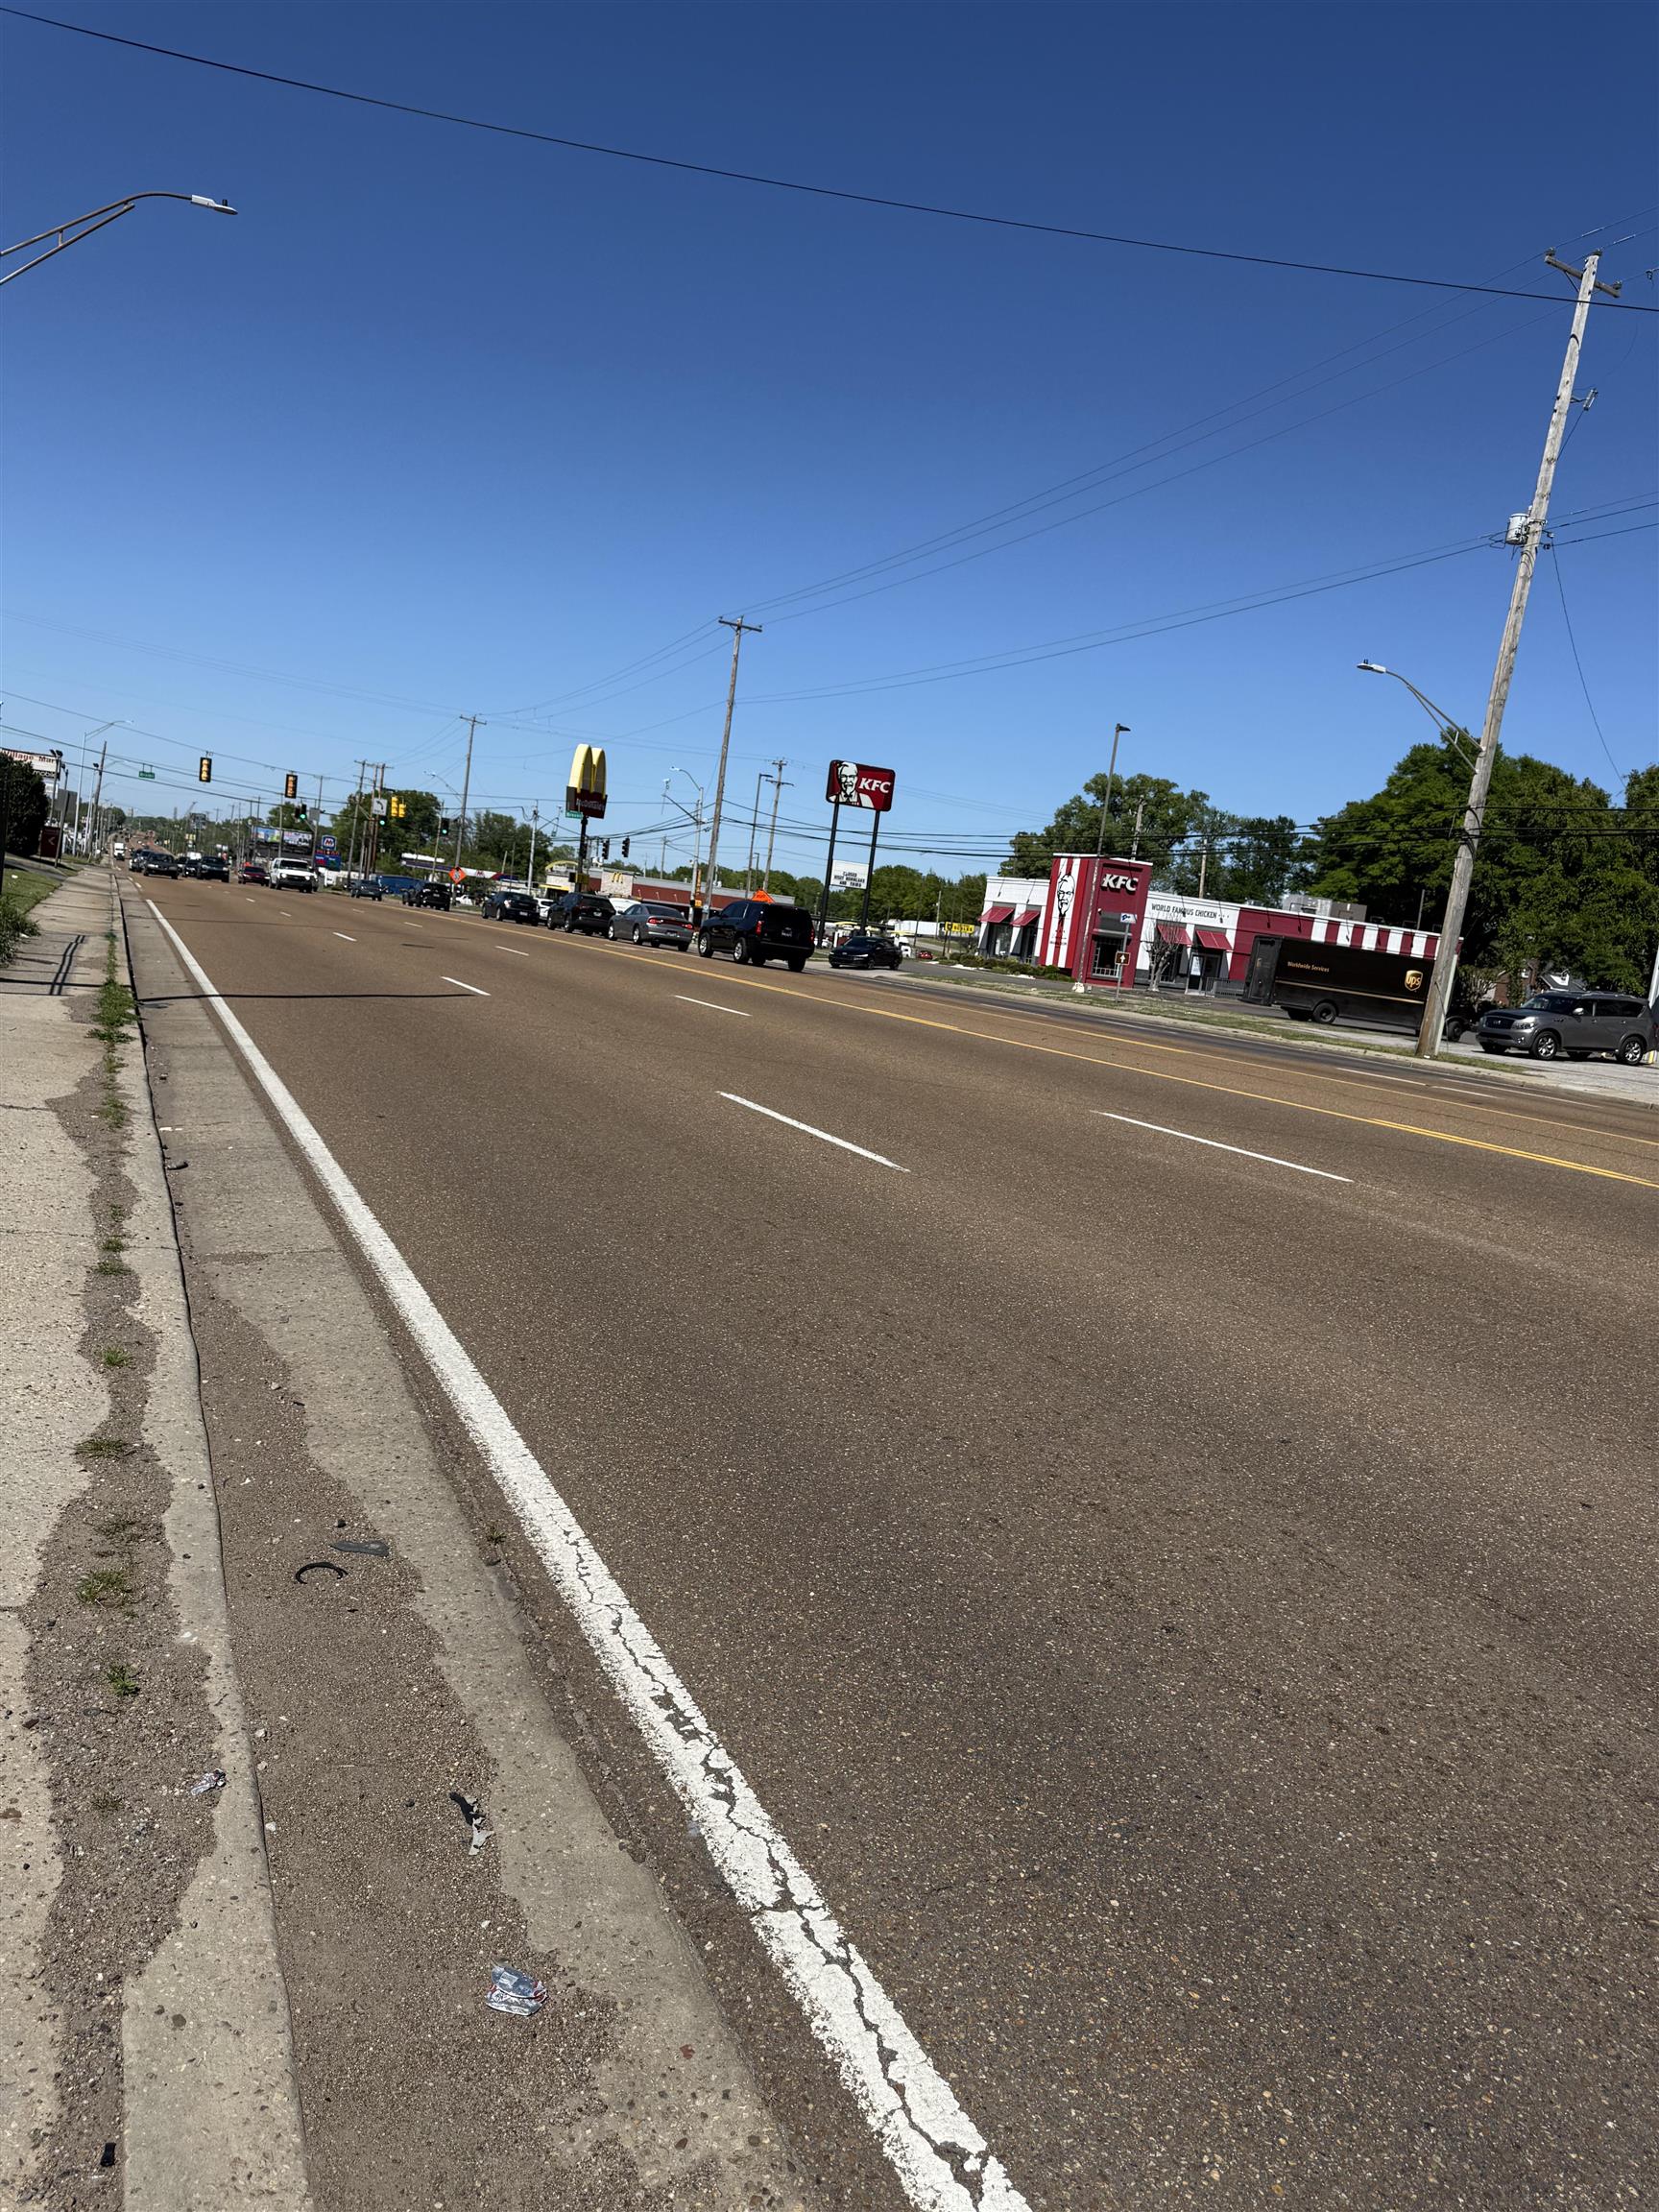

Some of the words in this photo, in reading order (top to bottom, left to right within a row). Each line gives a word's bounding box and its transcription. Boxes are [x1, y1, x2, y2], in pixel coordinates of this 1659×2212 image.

[858, 778, 891, 793] KFC
[1101, 873, 1139, 892] KFC
[1152, 903, 1171, 912] WORLD
[1194, 909, 1217, 919] CHICKEN
